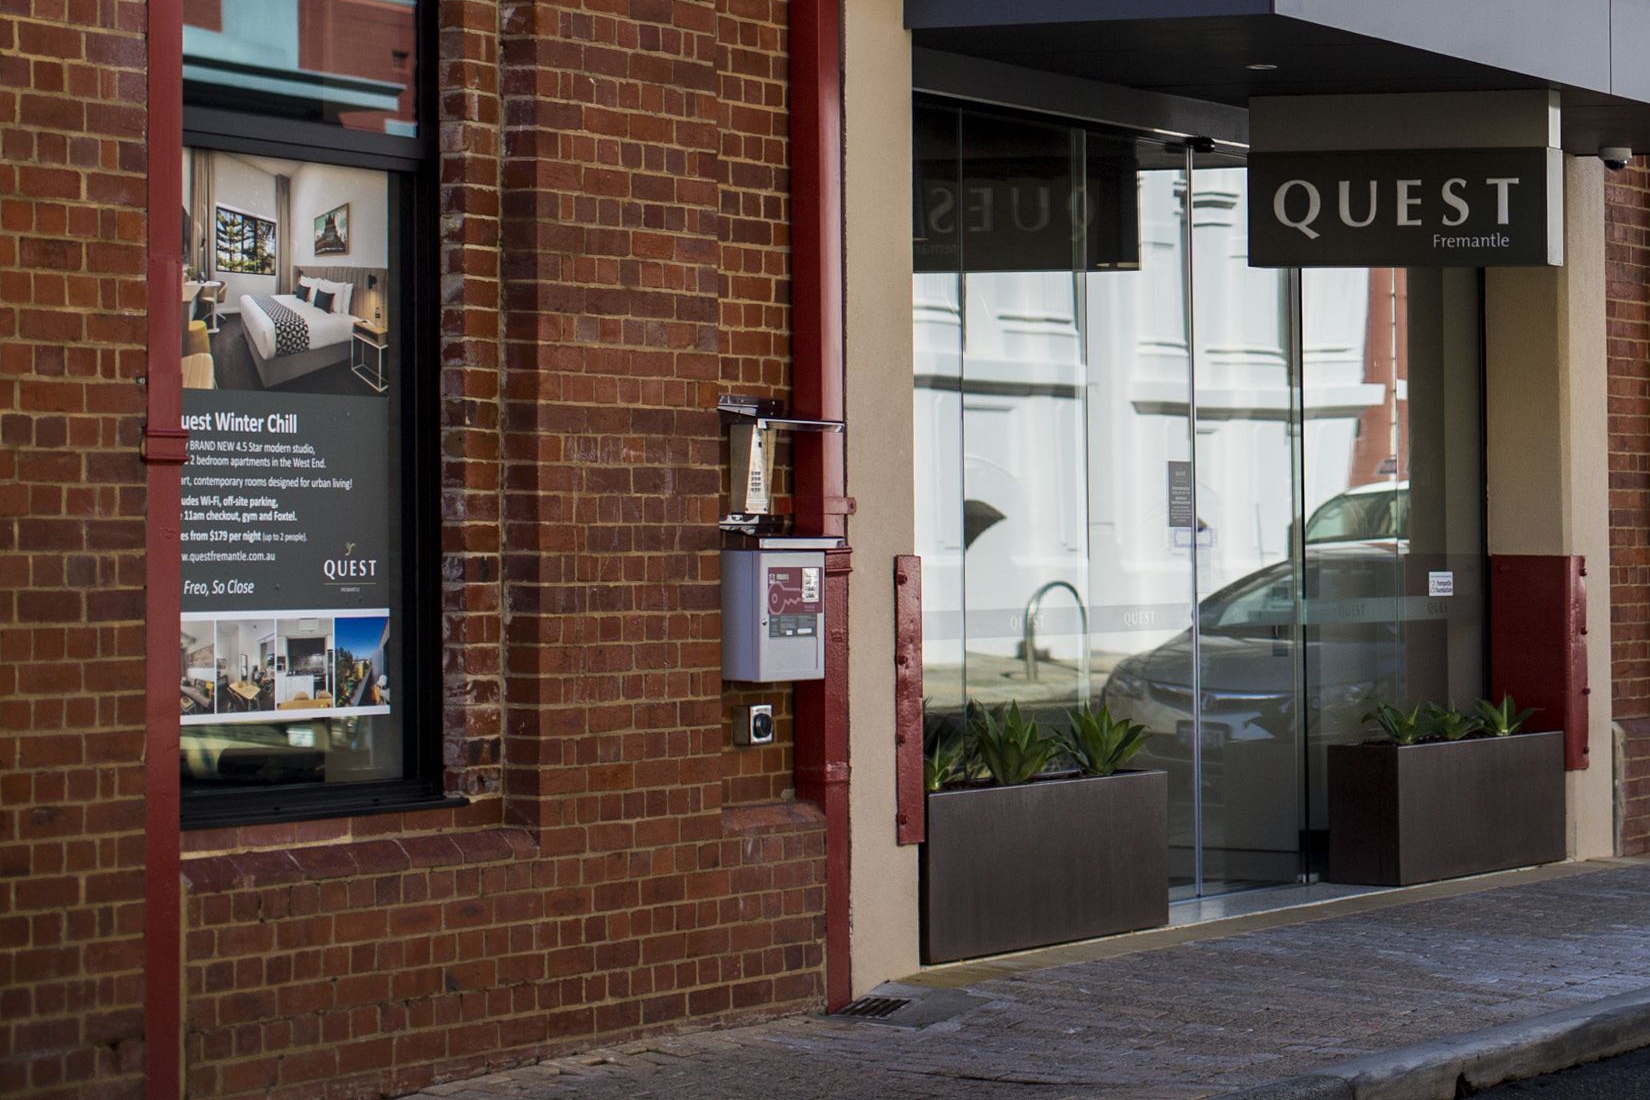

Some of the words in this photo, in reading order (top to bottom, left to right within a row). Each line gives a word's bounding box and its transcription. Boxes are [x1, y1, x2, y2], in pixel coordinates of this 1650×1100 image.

[1273, 177, 1520, 240] QUEST
[1432, 233, 1510, 249] Fremantle
[181, 413, 212, 431] uest
[215, 411, 264, 432] Winter
[267, 413, 297, 433] Chill
[190, 440, 215, 451] BRAND
[217, 441, 235, 451] NEW
[235, 441, 247, 452] 4.5
[248, 441, 262, 453] Star
[264, 442, 291, 453] modern
[292, 443, 315, 455] studio,
[190, 455, 195, 465] 2
[196, 455, 229, 466] bedroom
[230, 457, 270, 468] apartments
[271, 457, 278, 467] in
[280, 457, 291, 467] the
[292, 458, 310, 468] West
[311, 458, 327, 468] End.
[193, 477, 243, 488] contemporary
[245, 479, 267, 487] rooms
[268, 476, 299, 489] designed
[300, 477, 310, 487] for
[311, 478, 331, 488] urban
[223, 496, 248, 506] off-site
[184, 510, 204, 520] 11am
[206, 510, 241, 522] checkout,
[242, 512, 257, 523] gym
[258, 511, 272, 521] and
[190, 530, 208, 541] from
[209, 529, 228, 542] $179
[228, 531, 241, 543] per
[242, 530, 261, 543] night
[323, 559, 377, 580] QUEST
[183, 580, 209, 596] Freo,
[211, 580, 225, 595] So
[227, 579, 255, 594] Close
[1123, 611, 1156, 627] QUEST
